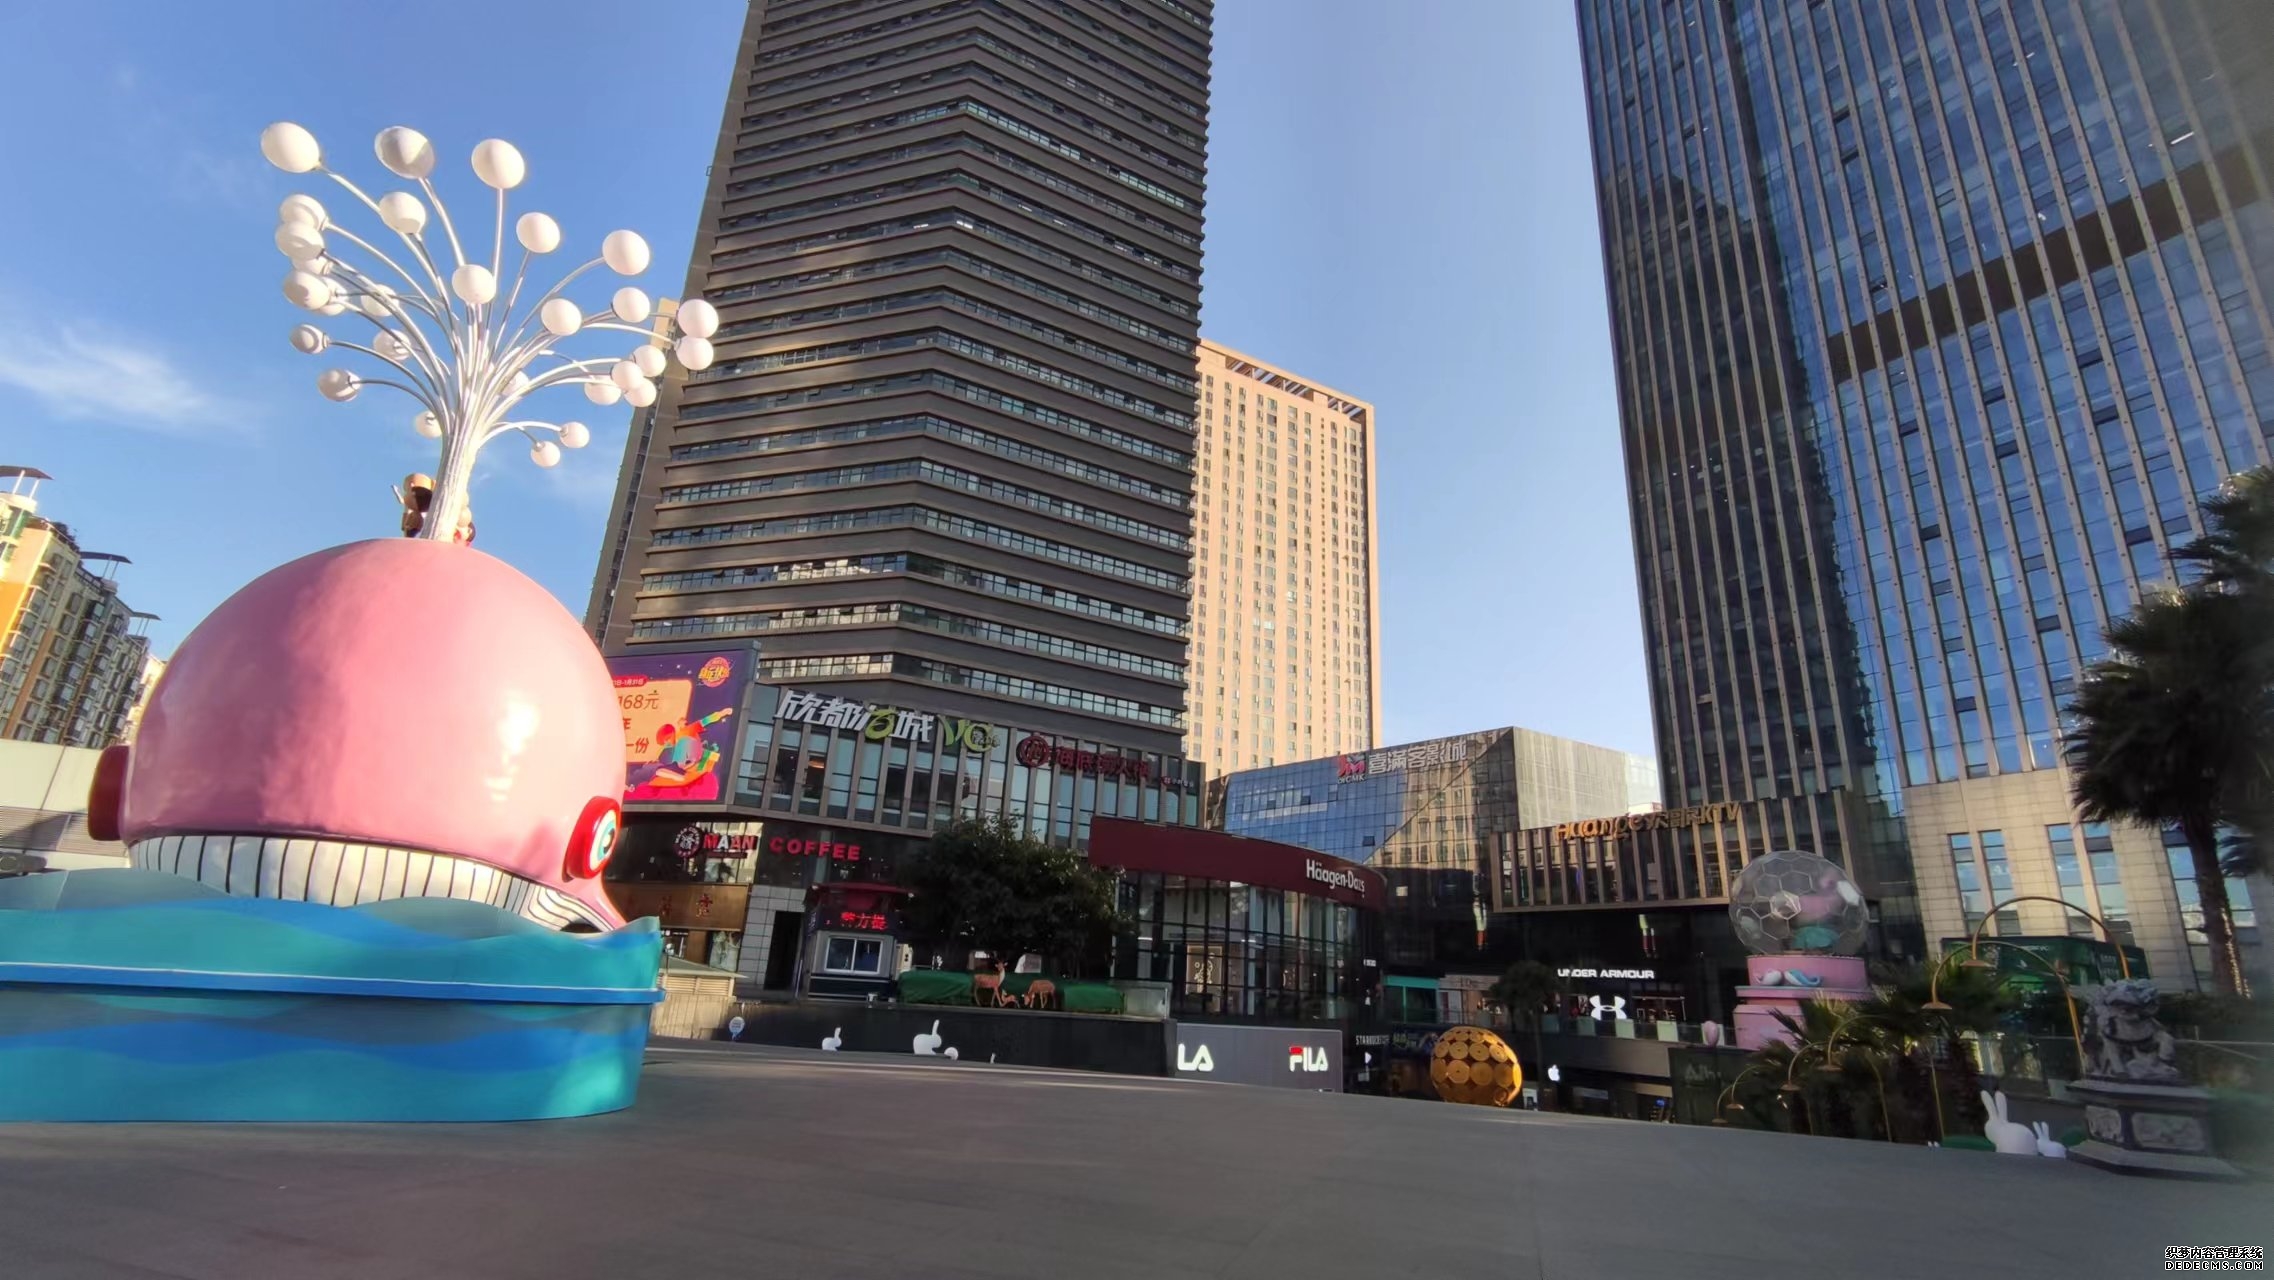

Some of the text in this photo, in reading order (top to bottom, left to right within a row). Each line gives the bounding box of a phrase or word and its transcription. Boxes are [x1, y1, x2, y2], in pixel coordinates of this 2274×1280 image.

[1369, 740, 1467, 774] 喜满客影城
[703, 833, 861, 861] MAAN COFFEE
[1306, 858, 1365, 892] Häagen-Dazs
[1557, 968, 1654, 979] UNDER ARMOUR
[1289, 1046, 1329, 1072] FILA
